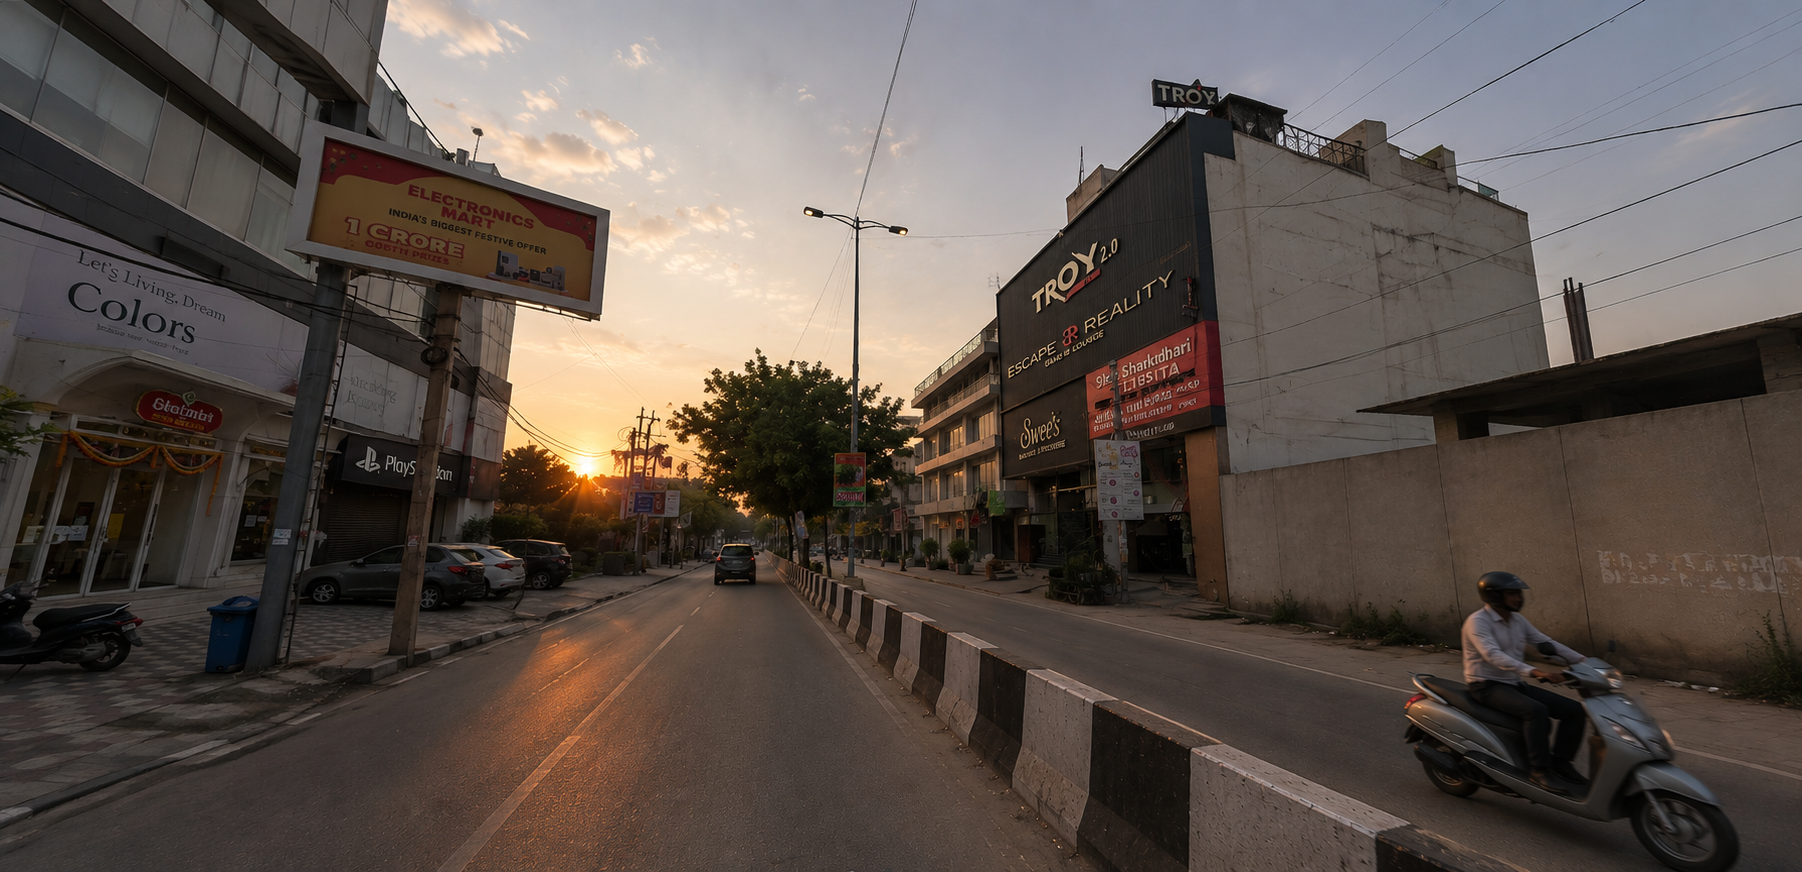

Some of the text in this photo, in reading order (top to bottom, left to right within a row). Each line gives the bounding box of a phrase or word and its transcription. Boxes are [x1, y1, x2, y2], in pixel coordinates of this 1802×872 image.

[1157, 84, 1216, 106] TROY
[408, 184, 535, 230] ELECTRONICS
[441, 206, 495, 230] MART
[345, 216, 465, 260] 1 CRORE
[388, 208, 547, 255] INDIA'S BIGGEST FESTIVE OFFER
[77, 249, 119, 281] Let's
[182, 294, 227, 323] Dream
[1031, 240, 1099, 314] TROY
[1099, 238, 1119, 264] 2.0
[68, 282, 196, 345] Colors
[1007, 340, 1057, 379] ESCAPE
[1084, 269, 1174, 334] REALITY
